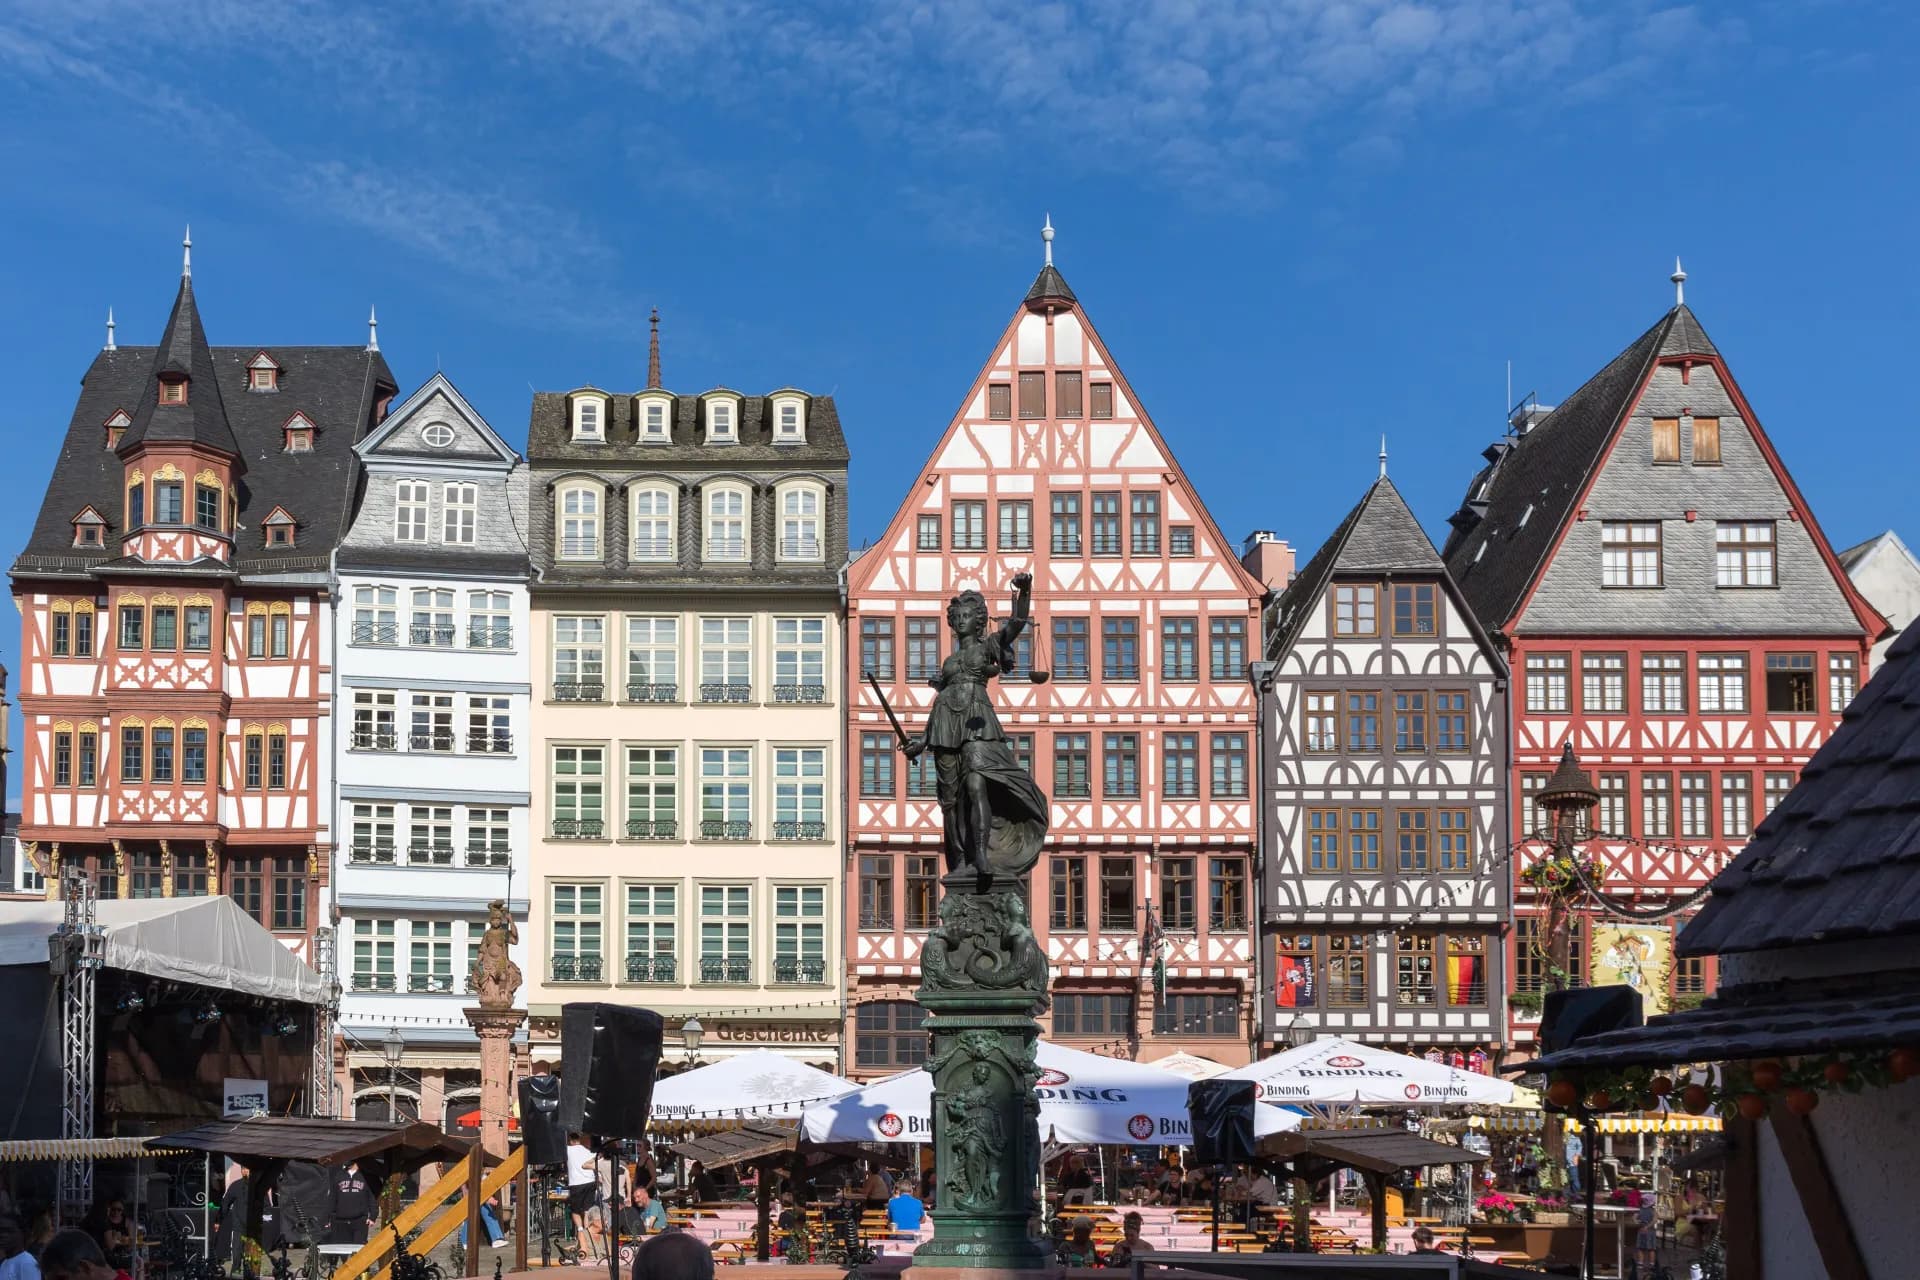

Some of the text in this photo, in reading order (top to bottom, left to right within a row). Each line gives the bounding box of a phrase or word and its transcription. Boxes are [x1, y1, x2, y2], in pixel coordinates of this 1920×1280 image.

[717, 1022, 828, 1041] Geschenke
[1298, 1069, 1403, 1078] BINDING
[1036, 1089, 1128, 1102] DING
[1267, 1084, 1310, 1096] BINDING
[1424, 1085, 1468, 1097] BINDING
[233, 1095, 262, 1108] RISE
[656, 1104, 696, 1115] BINDING
